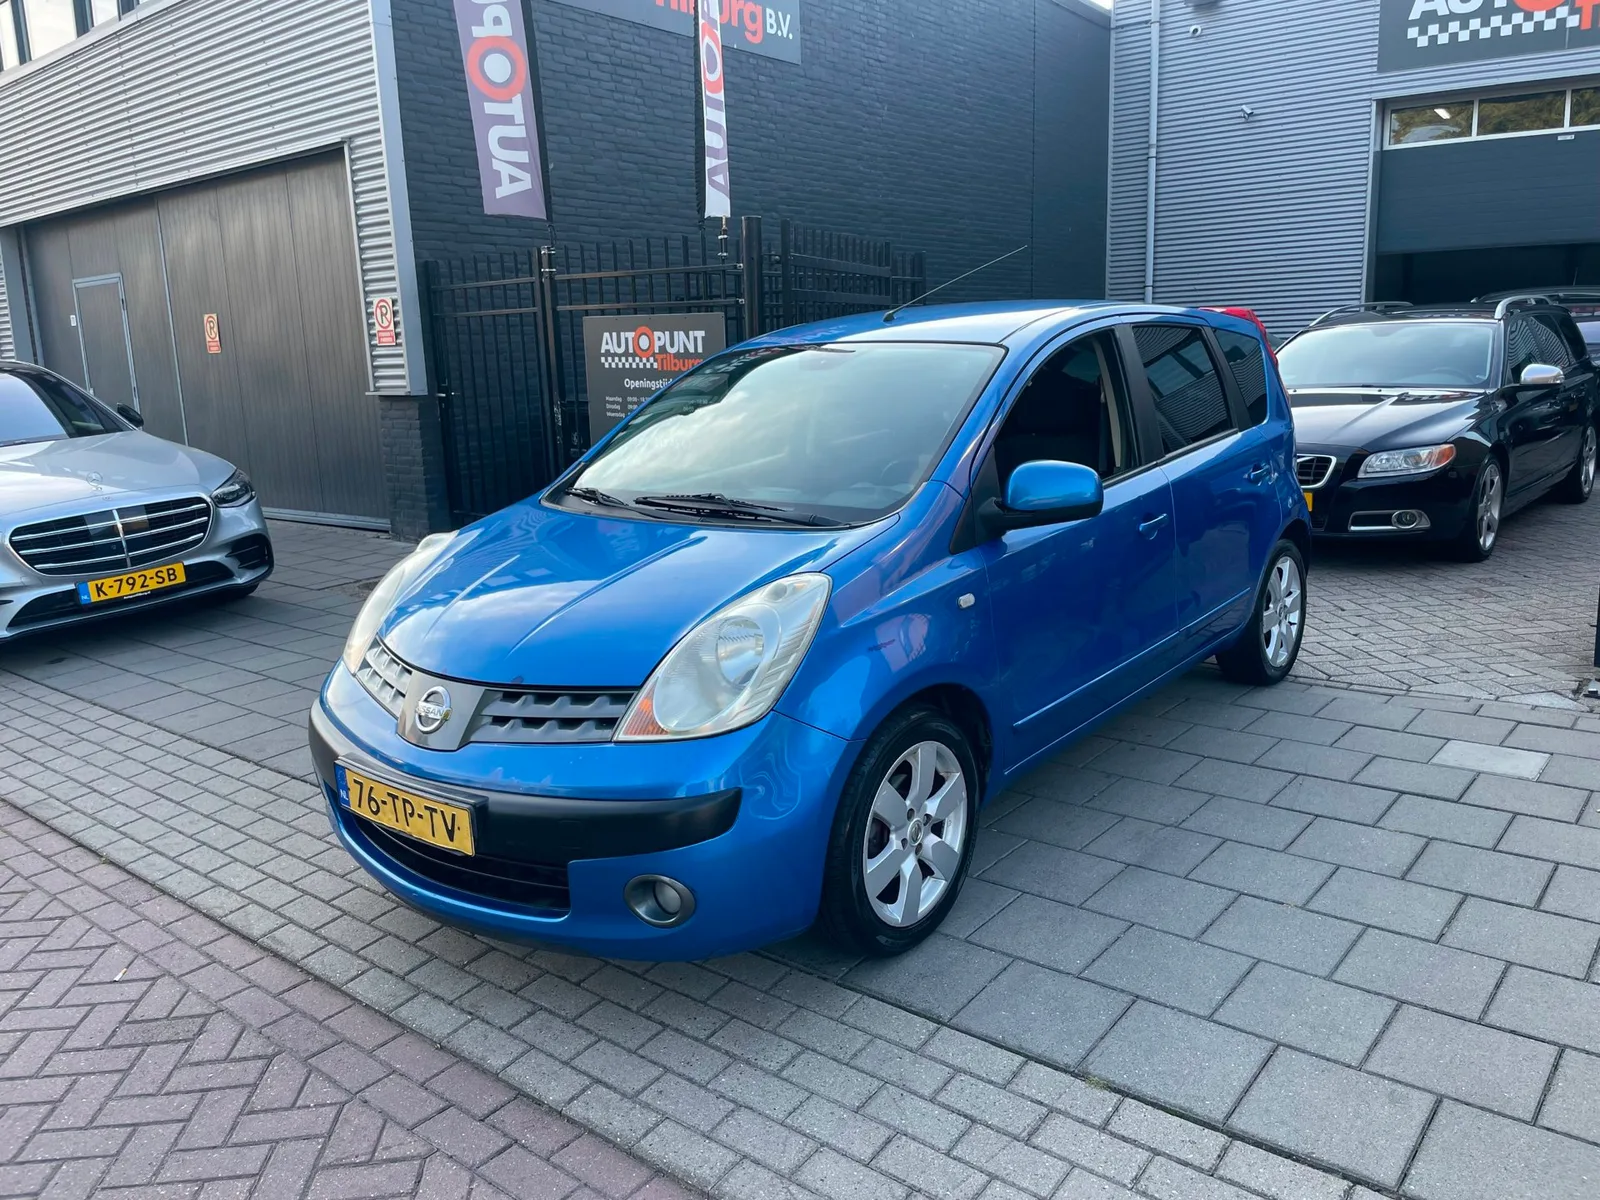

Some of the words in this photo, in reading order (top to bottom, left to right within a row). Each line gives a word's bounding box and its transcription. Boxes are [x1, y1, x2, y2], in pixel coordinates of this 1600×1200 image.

[765, 7, 793, 40] B.V.
[601, 326, 705, 358] AUTOPUNT
[95, 568, 177, 597] K-792-SB
[353, 779, 456, 842] 76-TP-TV
